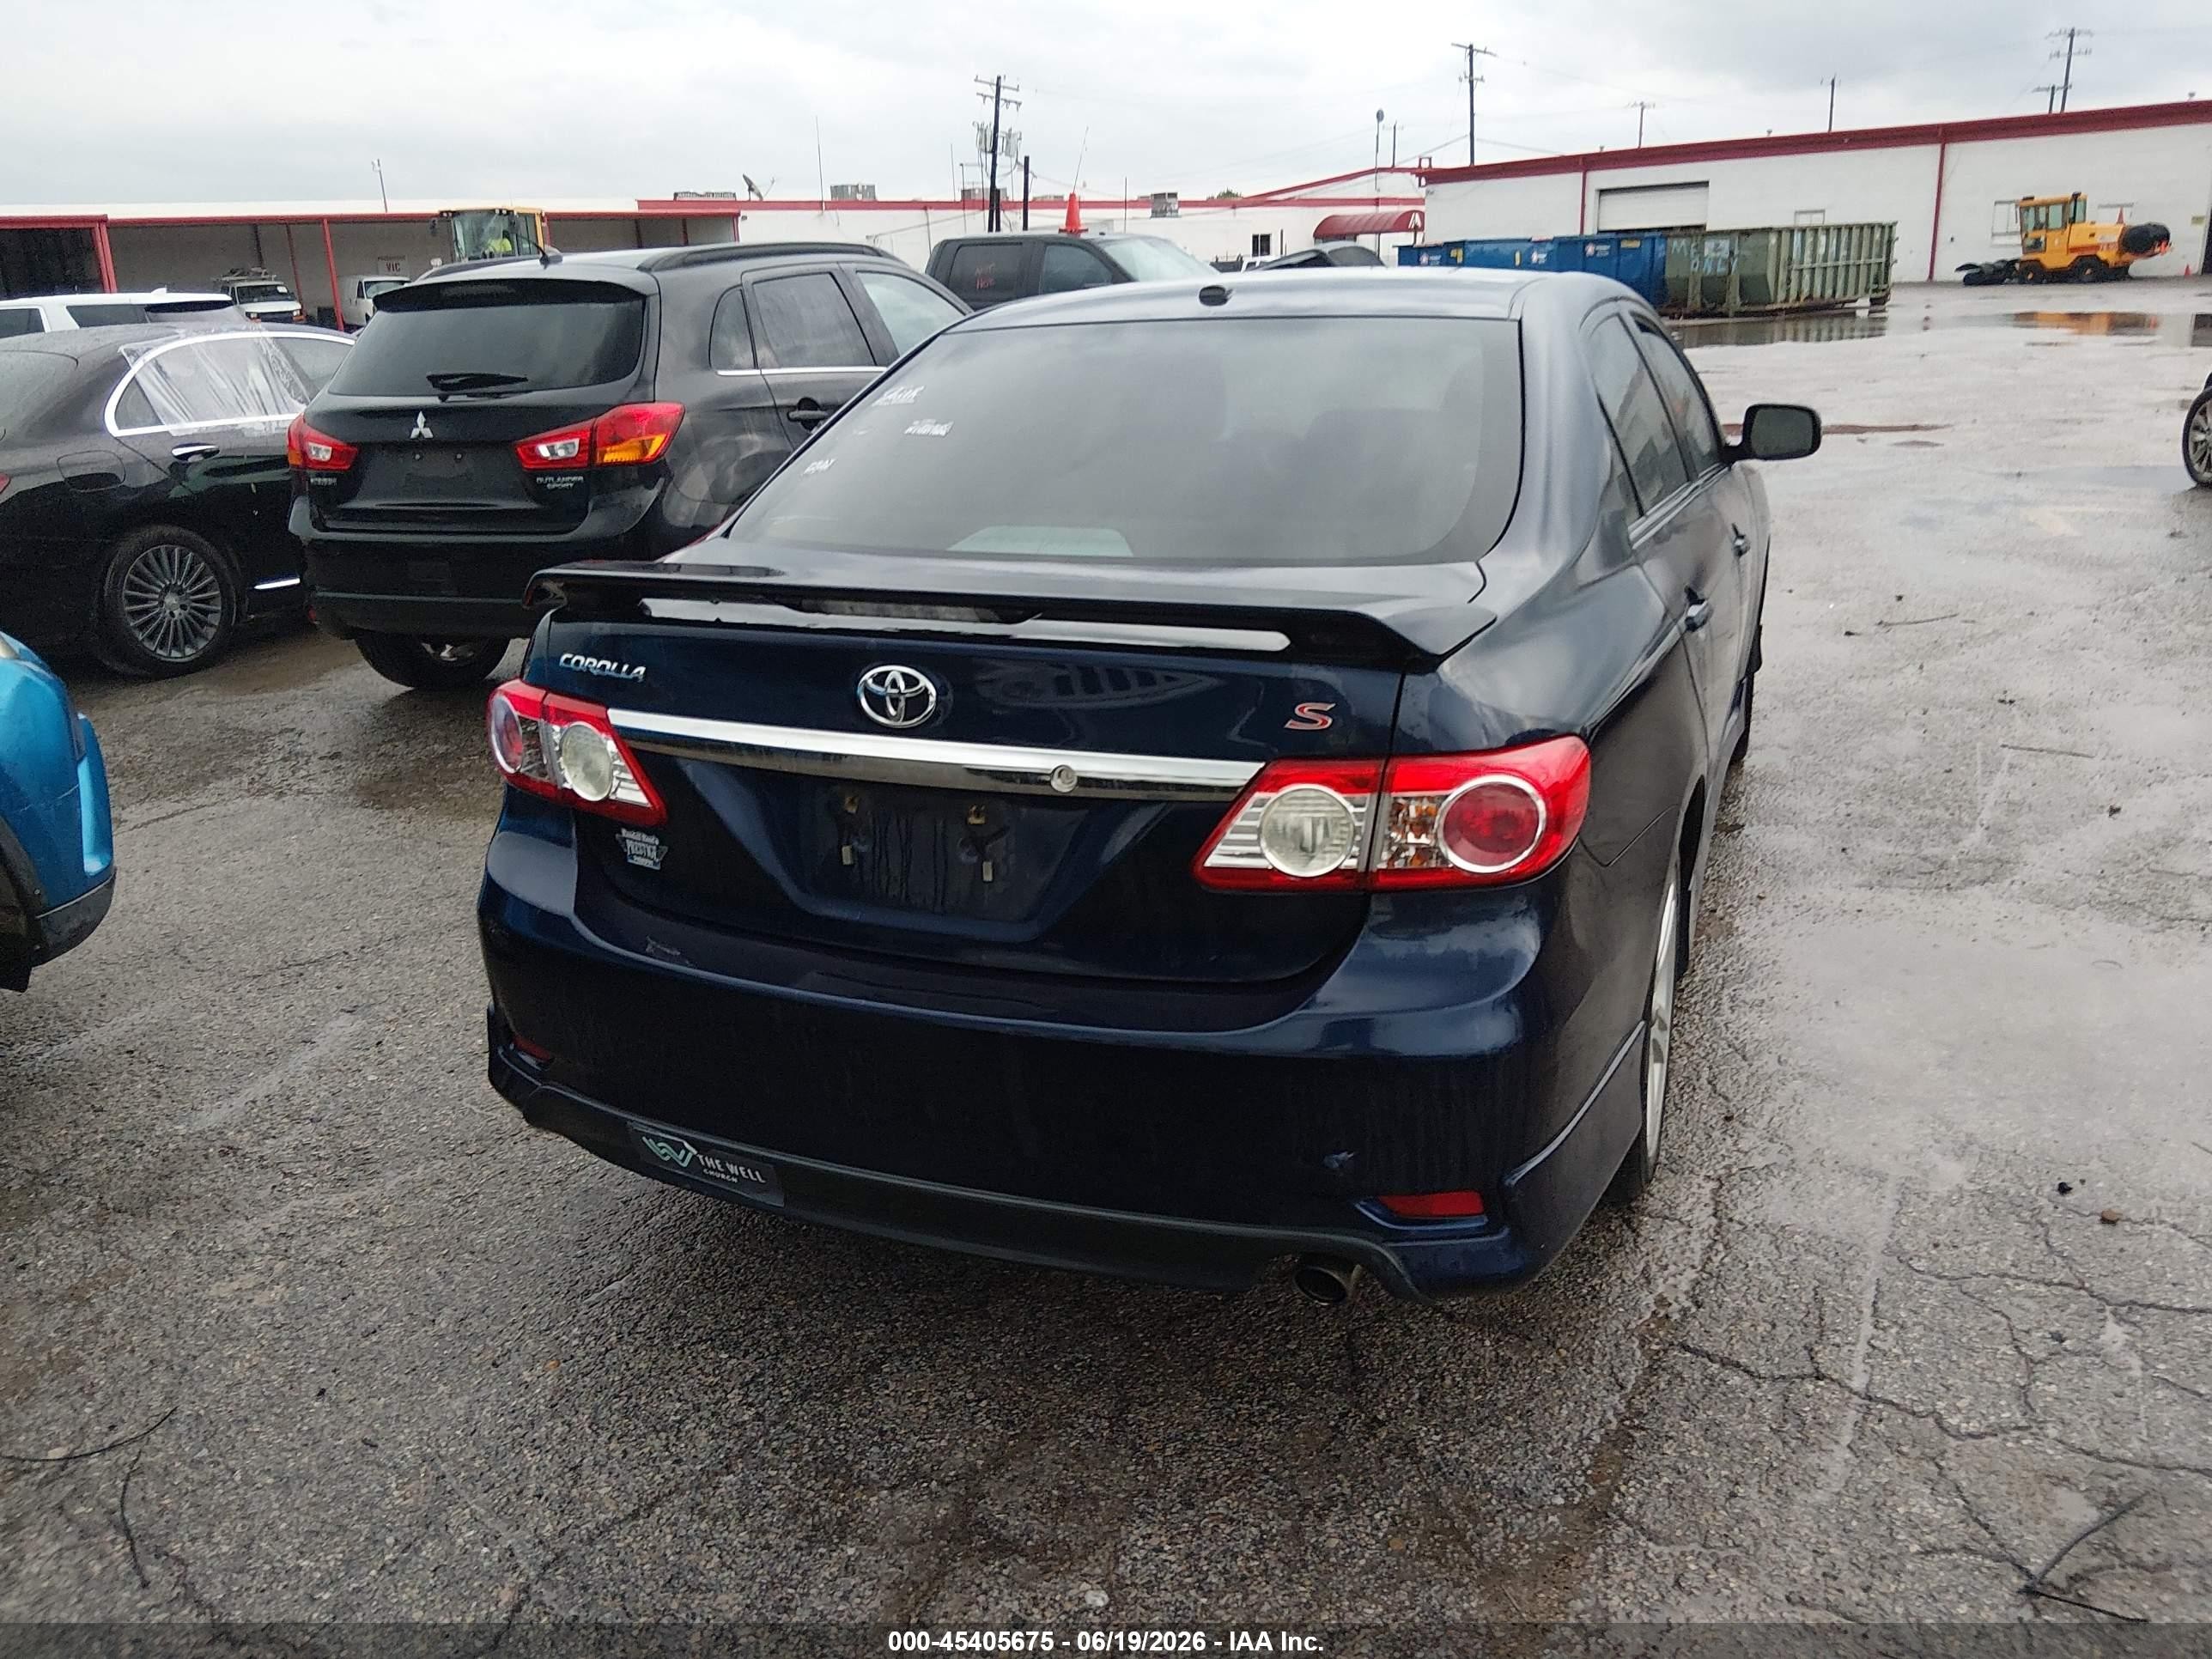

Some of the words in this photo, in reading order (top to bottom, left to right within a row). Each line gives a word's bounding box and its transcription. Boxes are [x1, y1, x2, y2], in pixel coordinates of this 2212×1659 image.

[559, 653, 646, 683] COROLLA
[1283, 702, 1336, 730] S
[696, 1153, 725, 1172] THE
[726, 1161, 766, 1183] WELL
[703, 1169, 738, 1183] CHURCH
